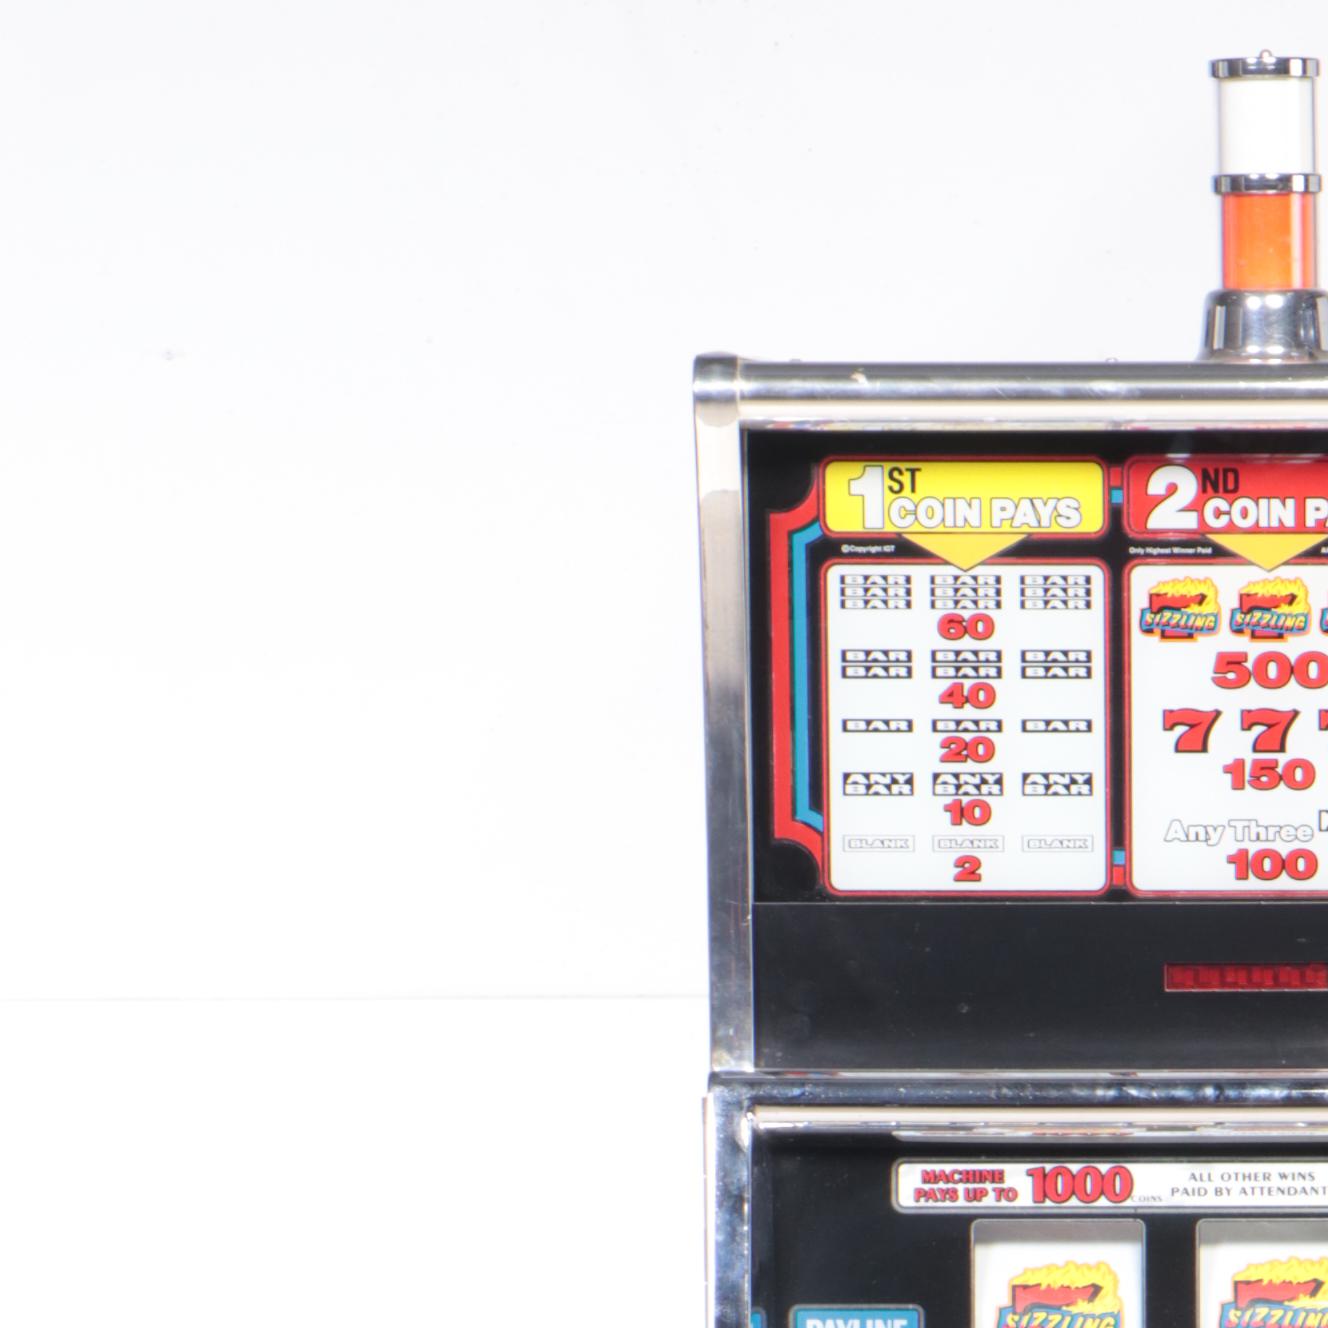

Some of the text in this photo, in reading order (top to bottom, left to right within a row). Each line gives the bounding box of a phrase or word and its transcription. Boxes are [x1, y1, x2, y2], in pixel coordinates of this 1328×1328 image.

[888, 497, 1082, 529] COIN PAYS
[1202, 497, 1296, 529] COIN
[1144, 609, 1216, 631] SIZZLING
[1234, 609, 1306, 631] SIZZLING
[937, 613, 995, 640] 60
[845, 651, 909, 662] BAR
[935, 651, 998, 662] BAR
[1025, 651, 1088, 662] BAR
[845, 667, 909, 678] BAR
[935, 667, 999, 678] BAR
[1025, 667, 1089, 678] BAR
[938, 682, 996, 709] 40
[846, 720, 909, 731] BAR
[935, 720, 999, 731] BAR
[1025, 720, 1089, 731] BAR
[1162, 708, 1223, 753] 7
[1240, 708, 1301, 753] 7
[939, 736, 995, 763] 20
[845, 773, 911, 784] ANY
[935, 773, 1001, 784] ANY
[1025, 773, 1091, 784] ANY
[1222, 758, 1316, 791] 150
[844, 784, 912, 795] BAR
[934, 784, 1002, 795] BAR
[1023, 784, 1091, 795] BAR
[943, 799, 992, 826] 10
[1164, 819, 1226, 846] Any
[1228, 819, 1314, 842] Three
[848, 839, 909, 849] BLANK
[938, 839, 999, 849] BLANK
[1027, 839, 1088, 849] BLANK
[953, 855, 982, 882] 2
[1227, 848, 1318, 880] 100
[921, 1169, 1005, 1184] MACHINE
[1189, 1172, 1316, 1182] ALL OTHER WINS
[1026, 1164, 1134, 1204] 1000
[913, 1187, 1019, 1202] PAYS UP TO
[1171, 1186, 1328, 1197] PAID BY ATTENDANT
